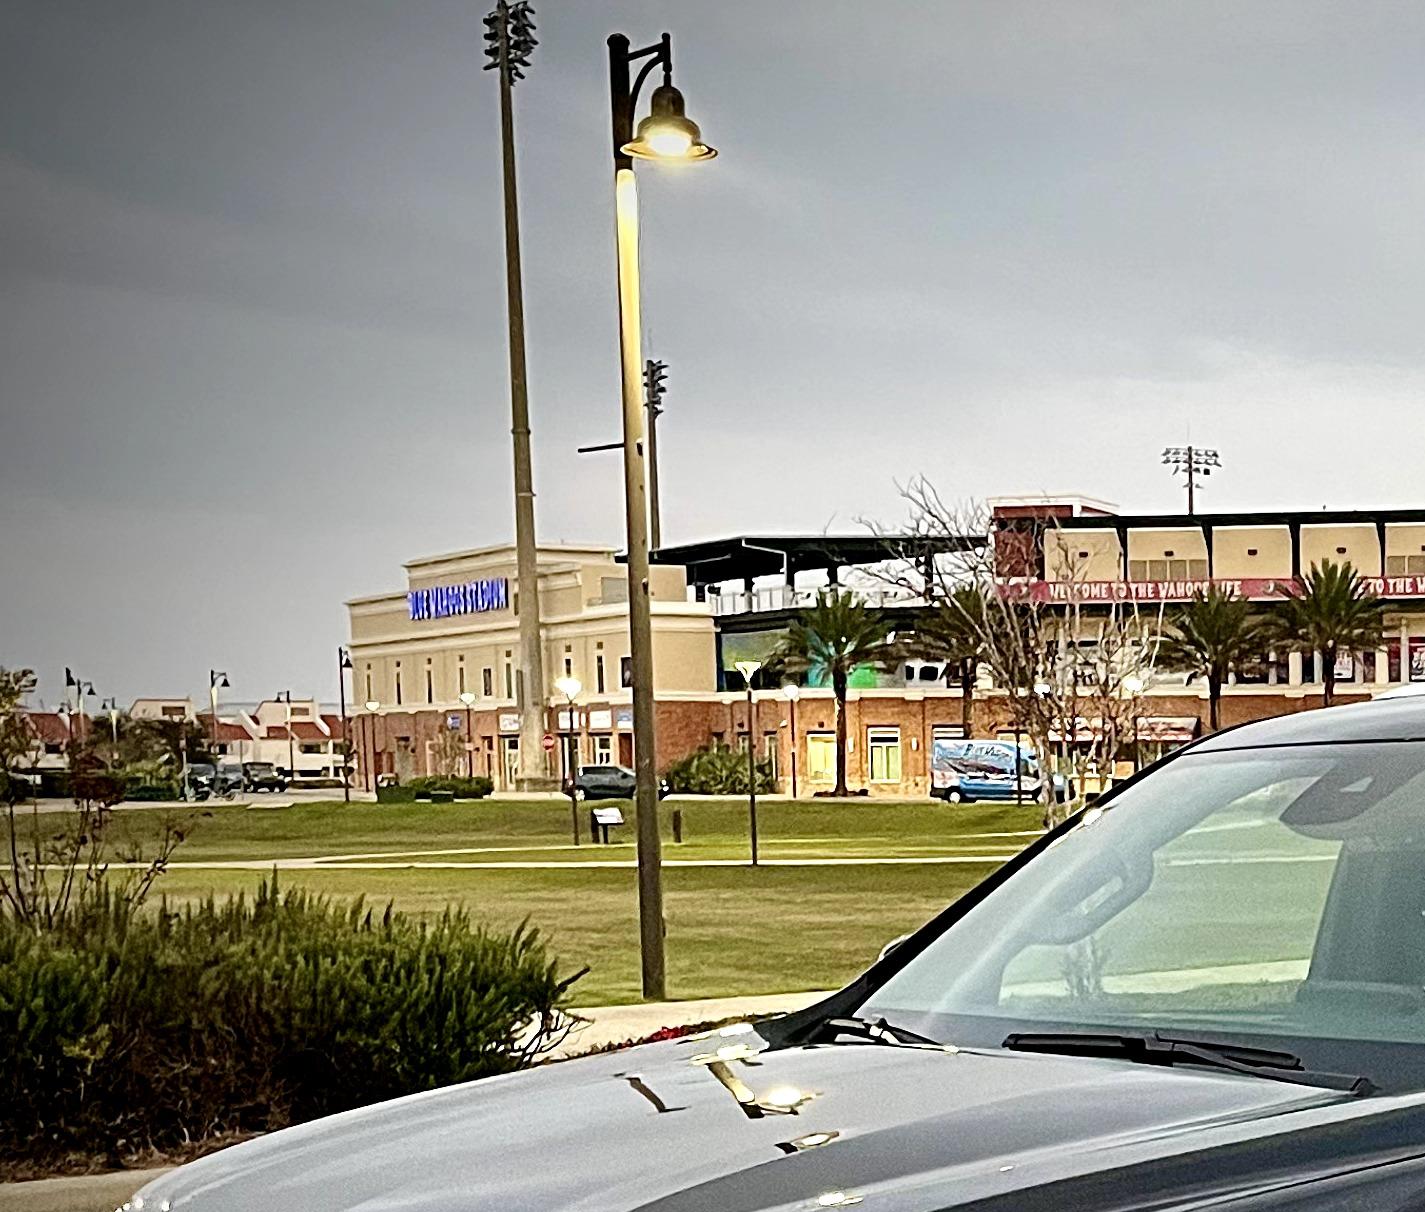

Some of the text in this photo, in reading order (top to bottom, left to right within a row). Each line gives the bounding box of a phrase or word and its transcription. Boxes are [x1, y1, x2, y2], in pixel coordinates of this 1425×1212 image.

[1129, 582, 1155, 598] THE
[1216, 580, 1242, 597] IFE
[1368, 578, 1385, 595] TO
[1386, 578, 1413, 594] THE
